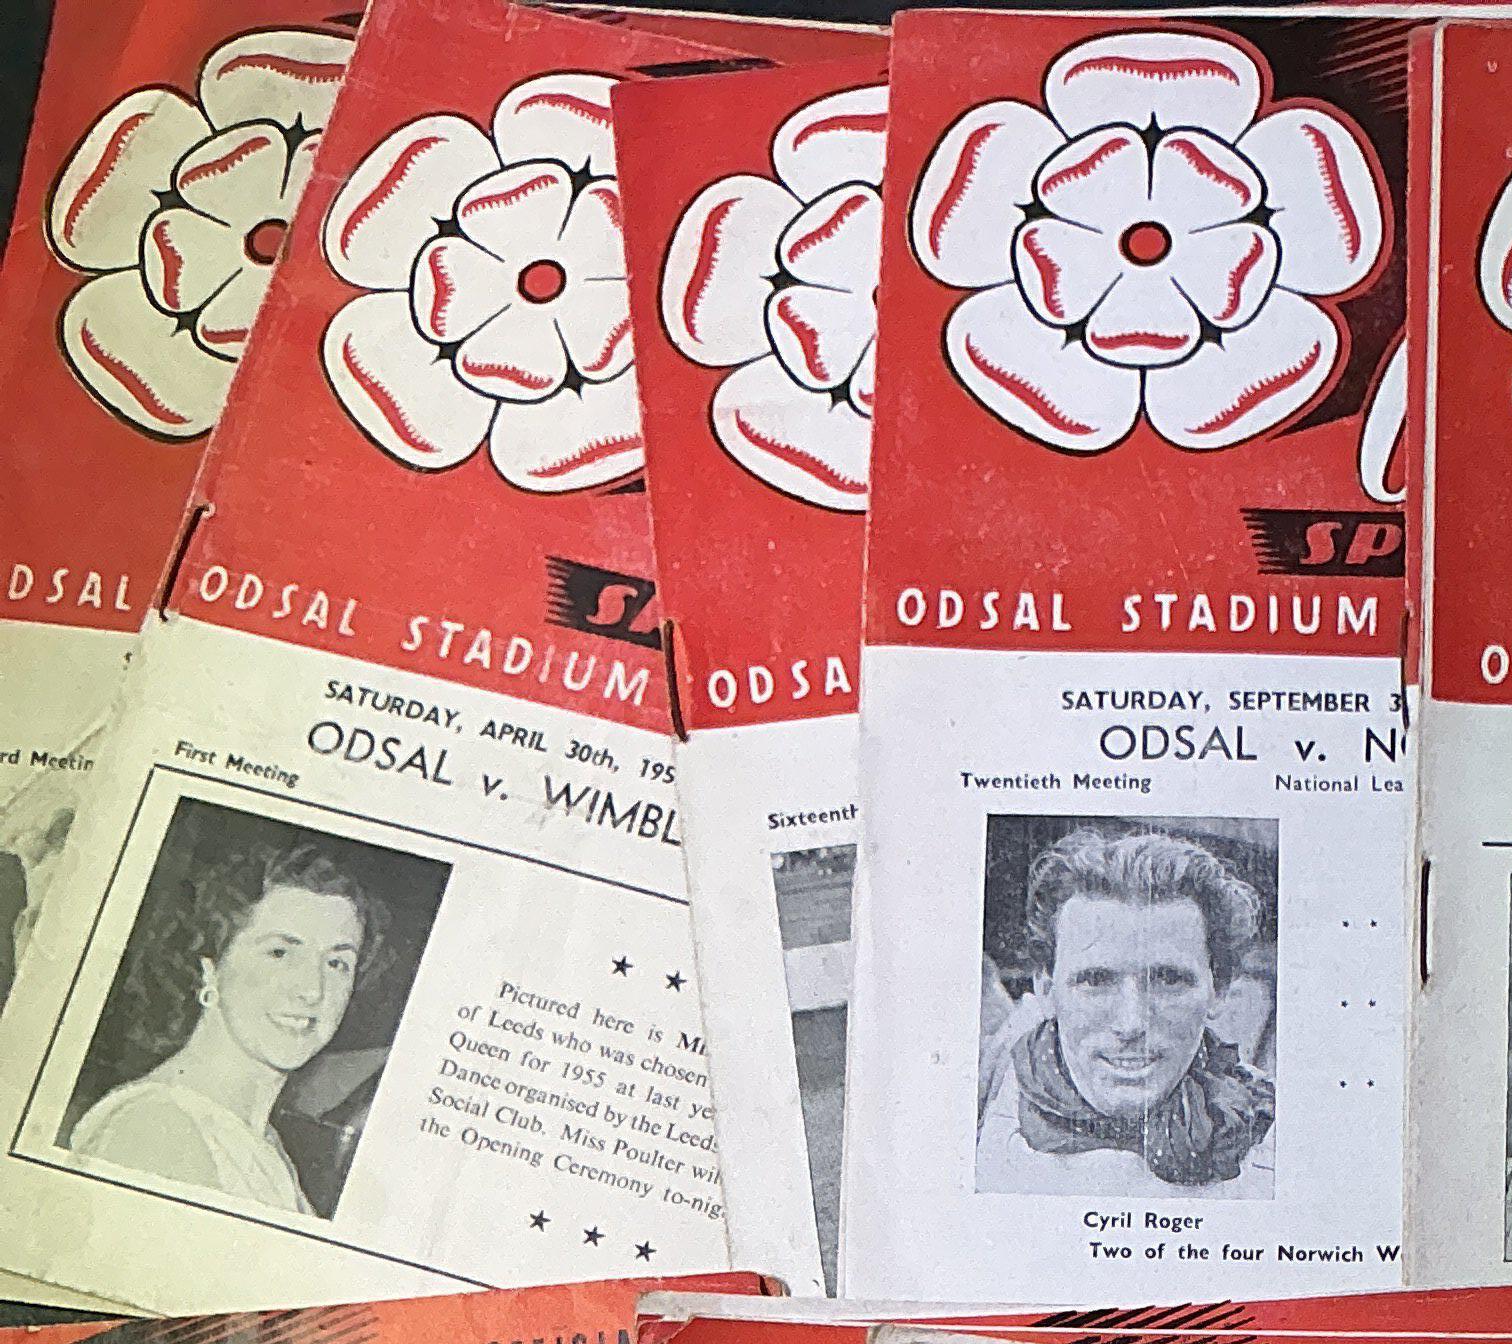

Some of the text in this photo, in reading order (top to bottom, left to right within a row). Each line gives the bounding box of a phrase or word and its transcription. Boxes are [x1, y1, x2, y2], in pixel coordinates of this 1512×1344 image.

[200, 566, 651, 706] ODSAL STADIUM
[896, 587, 1379, 637] ODSAL STADIUM
[708, 656, 852, 709] ODSA
[1061, 690, 1371, 714] SATURDAY, SEPTEMBER
[324, 680, 548, 753] SATURDAY, APRIL
[174, 740, 301, 789] First Meeting
[1099, 724, 1258, 761] ODSAL
[308, 721, 683, 847] ODSAL WIMBL
[960, 772, 1153, 794] Twentieth Meeting
[1275, 774, 1359, 793] National
[499, 980, 636, 1036] Pictured here
[448, 1030, 511, 1062] Queen
[488, 1010, 708, 1089] Leeds chosen
[439, 1058, 600, 1119] Dance organised
[428, 1086, 687, 1175] Social Poulter
[460, 1126, 654, 1199] Opening Ceremony
[1083, 1210, 1205, 1233] Cyril Roger
[1088, 1241, 1364, 1263] Two the four Norwich
